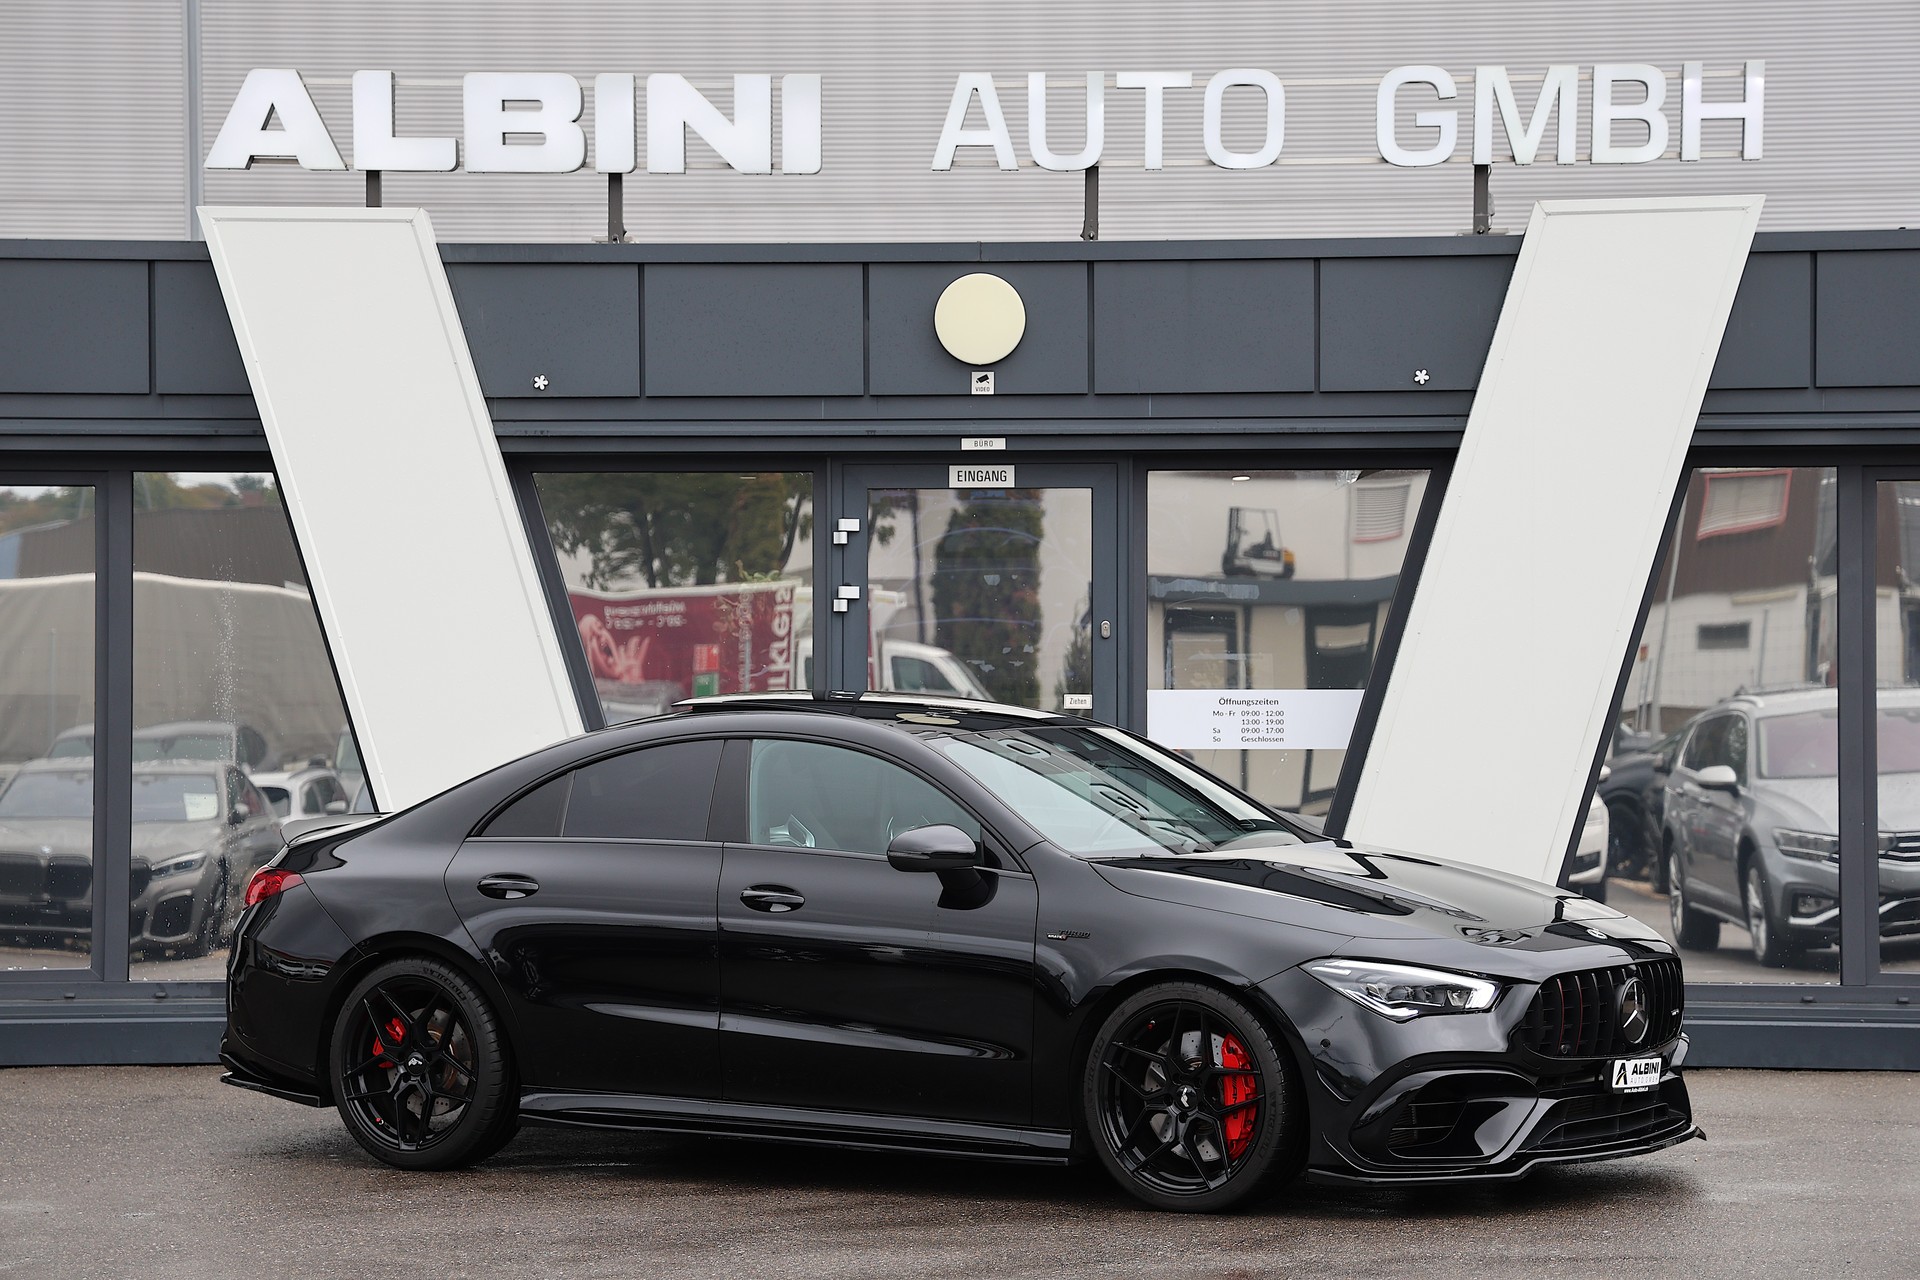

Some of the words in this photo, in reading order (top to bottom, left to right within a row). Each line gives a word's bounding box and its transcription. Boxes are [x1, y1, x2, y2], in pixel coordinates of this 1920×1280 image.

[204, 68, 823, 175] ALBINI
[931, 68, 1286, 172] AUTO
[1376, 59, 1766, 166] GMBH
[957, 470, 1007, 482] EINGANG
[1069, 697, 1087, 705] Ziehen
[1218, 697, 1279, 707] Öffnungszeiten
[1241, 735, 1285, 743] Geschlossen
[1632, 1062, 1659, 1075] ALBINI
